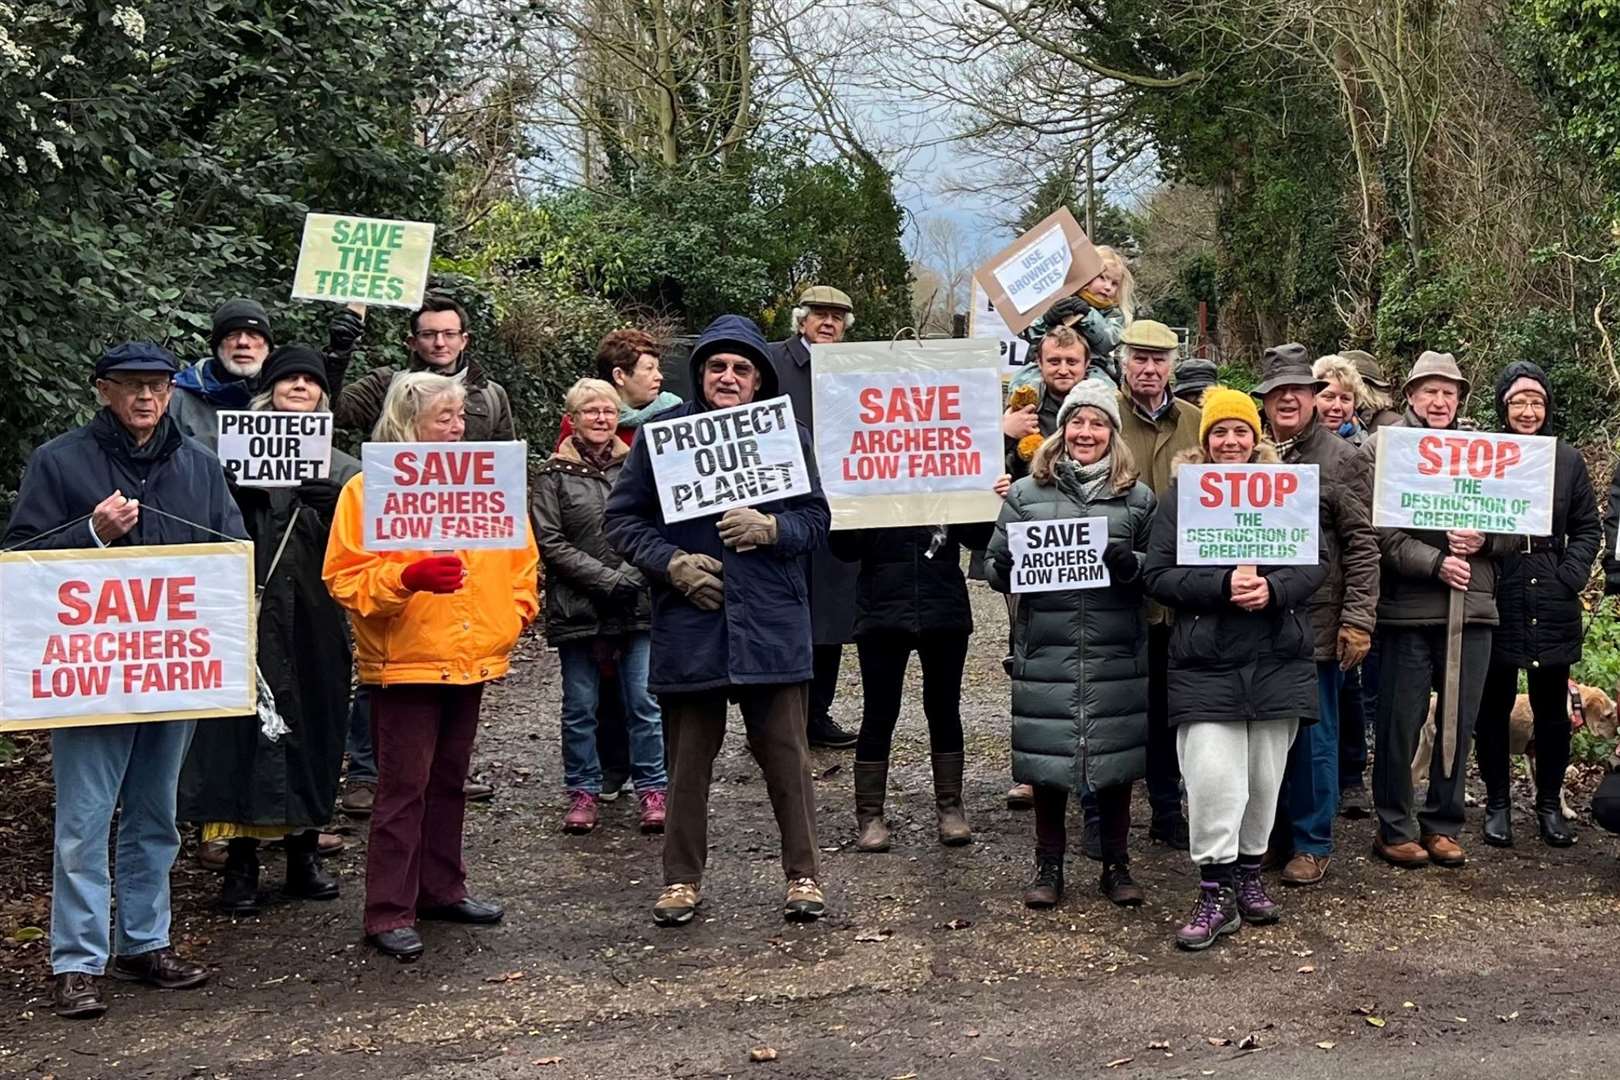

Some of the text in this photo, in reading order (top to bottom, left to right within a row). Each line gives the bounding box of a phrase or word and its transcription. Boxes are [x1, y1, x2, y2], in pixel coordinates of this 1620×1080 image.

[331, 220, 405, 248] SAVE
[338, 246, 391, 273] THE
[1022, 248, 1045, 270] USE
[315, 270, 404, 300] TREES
[1033, 269, 1063, 294] SITES
[859, 385, 961, 424] SAVE
[221, 415, 330, 435] PROTECT
[651, 402, 787, 455] PROTECT
[249, 437, 301, 458] OUR
[850, 426, 972, 454] ARCHERS
[226, 459, 323, 480] PLANET
[394, 451, 495, 486] SAVE
[694, 439, 762, 477] OUR
[842, 452, 981, 481] LOW FARM
[1417, 435, 1521, 480] STOP
[671, 461, 794, 512] PLANET
[1200, 472, 1298, 508] STOP
[1452, 478, 1482, 494] THE
[383, 491, 505, 515] ARCHERS
[1401, 493, 1531, 515] DESTRUCTION OF
[376, 516, 513, 540] LOW FARM
[1234, 513, 1262, 526] THE
[1412, 511, 1516, 531] GREENFIELDS
[1026, 523, 1090, 549] SAVE
[1186, 528, 1309, 543] DESTRUCTION OF
[1021, 549, 1097, 569] ARCHERS
[1199, 544, 1297, 558] GREENFIELDS
[1017, 564, 1104, 586] LOW FARM
[57, 576, 197, 626] SAVE
[42, 628, 211, 665] ARCHERS
[32, 660, 222, 698] LOW FARM
